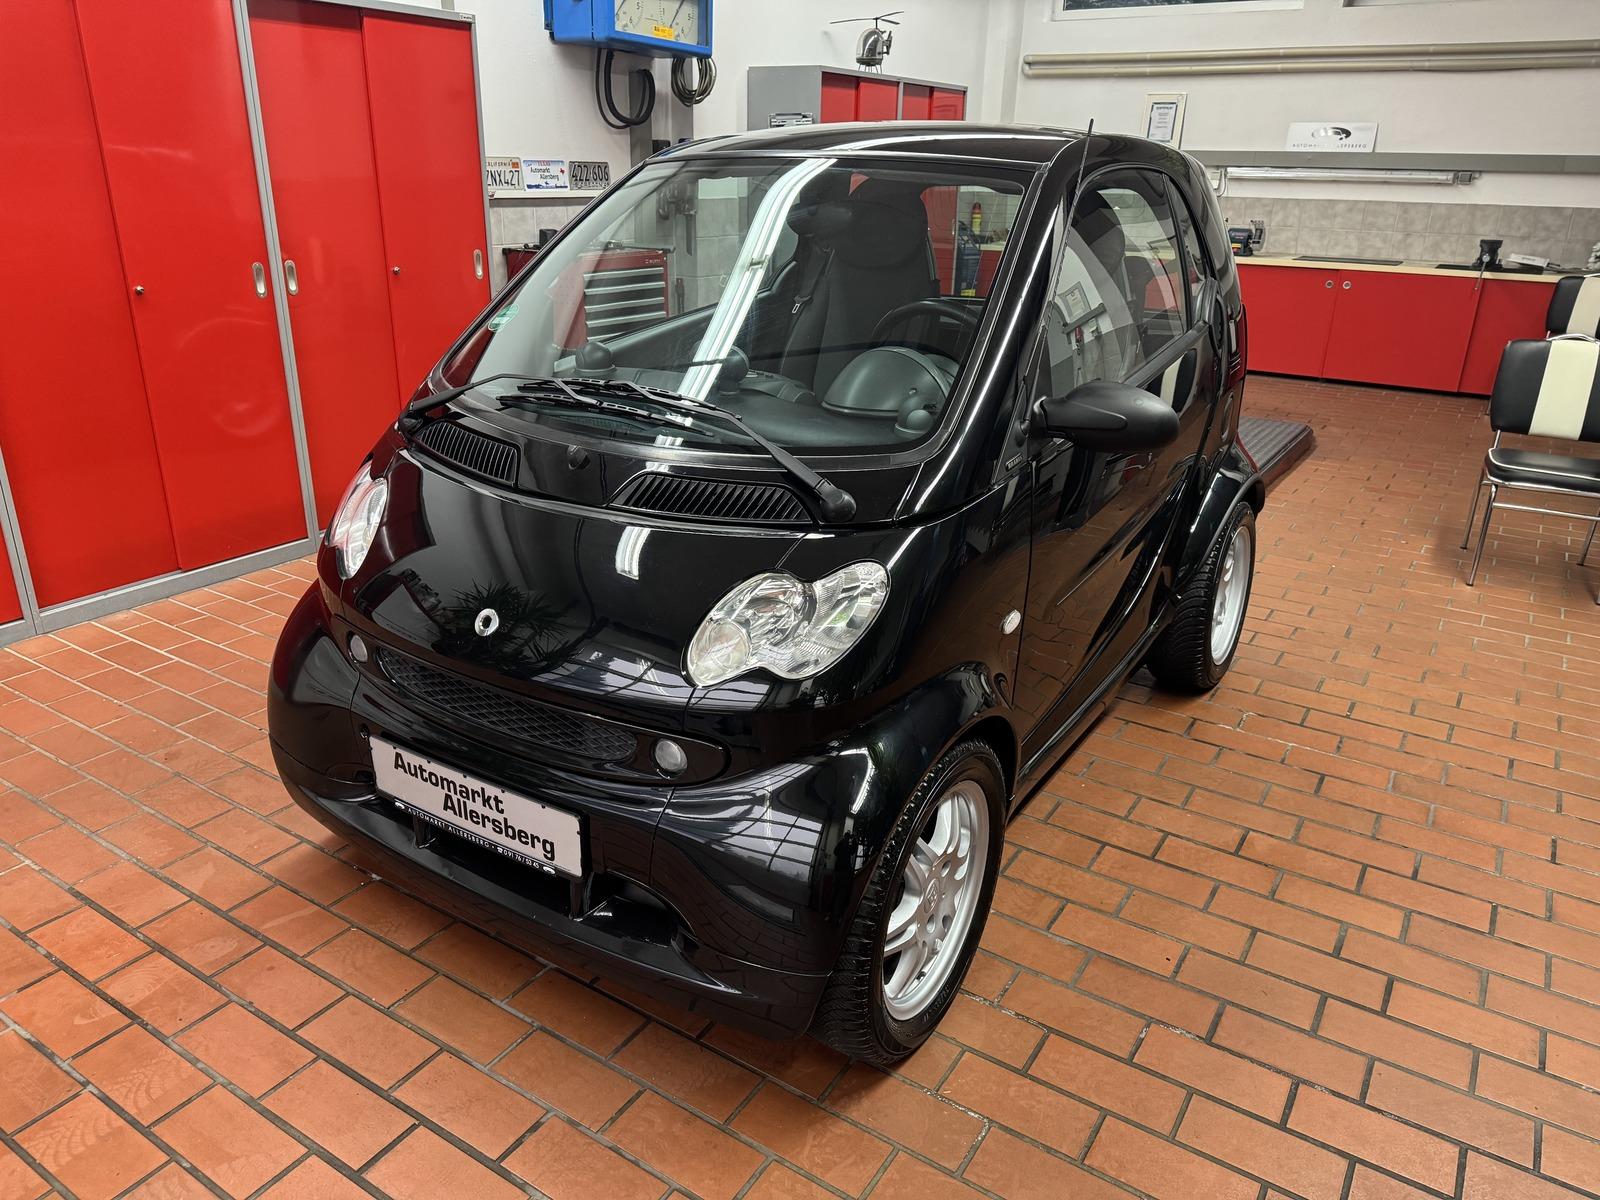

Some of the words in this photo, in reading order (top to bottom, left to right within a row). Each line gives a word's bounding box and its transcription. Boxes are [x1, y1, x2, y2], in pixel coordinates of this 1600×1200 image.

[393, 751, 505, 815] Automarkt
[407, 807, 446, 829] AUTOMARKT
[448, 826, 490, 848] ALLERSBERG
[442, 793, 556, 862] Allersberg
